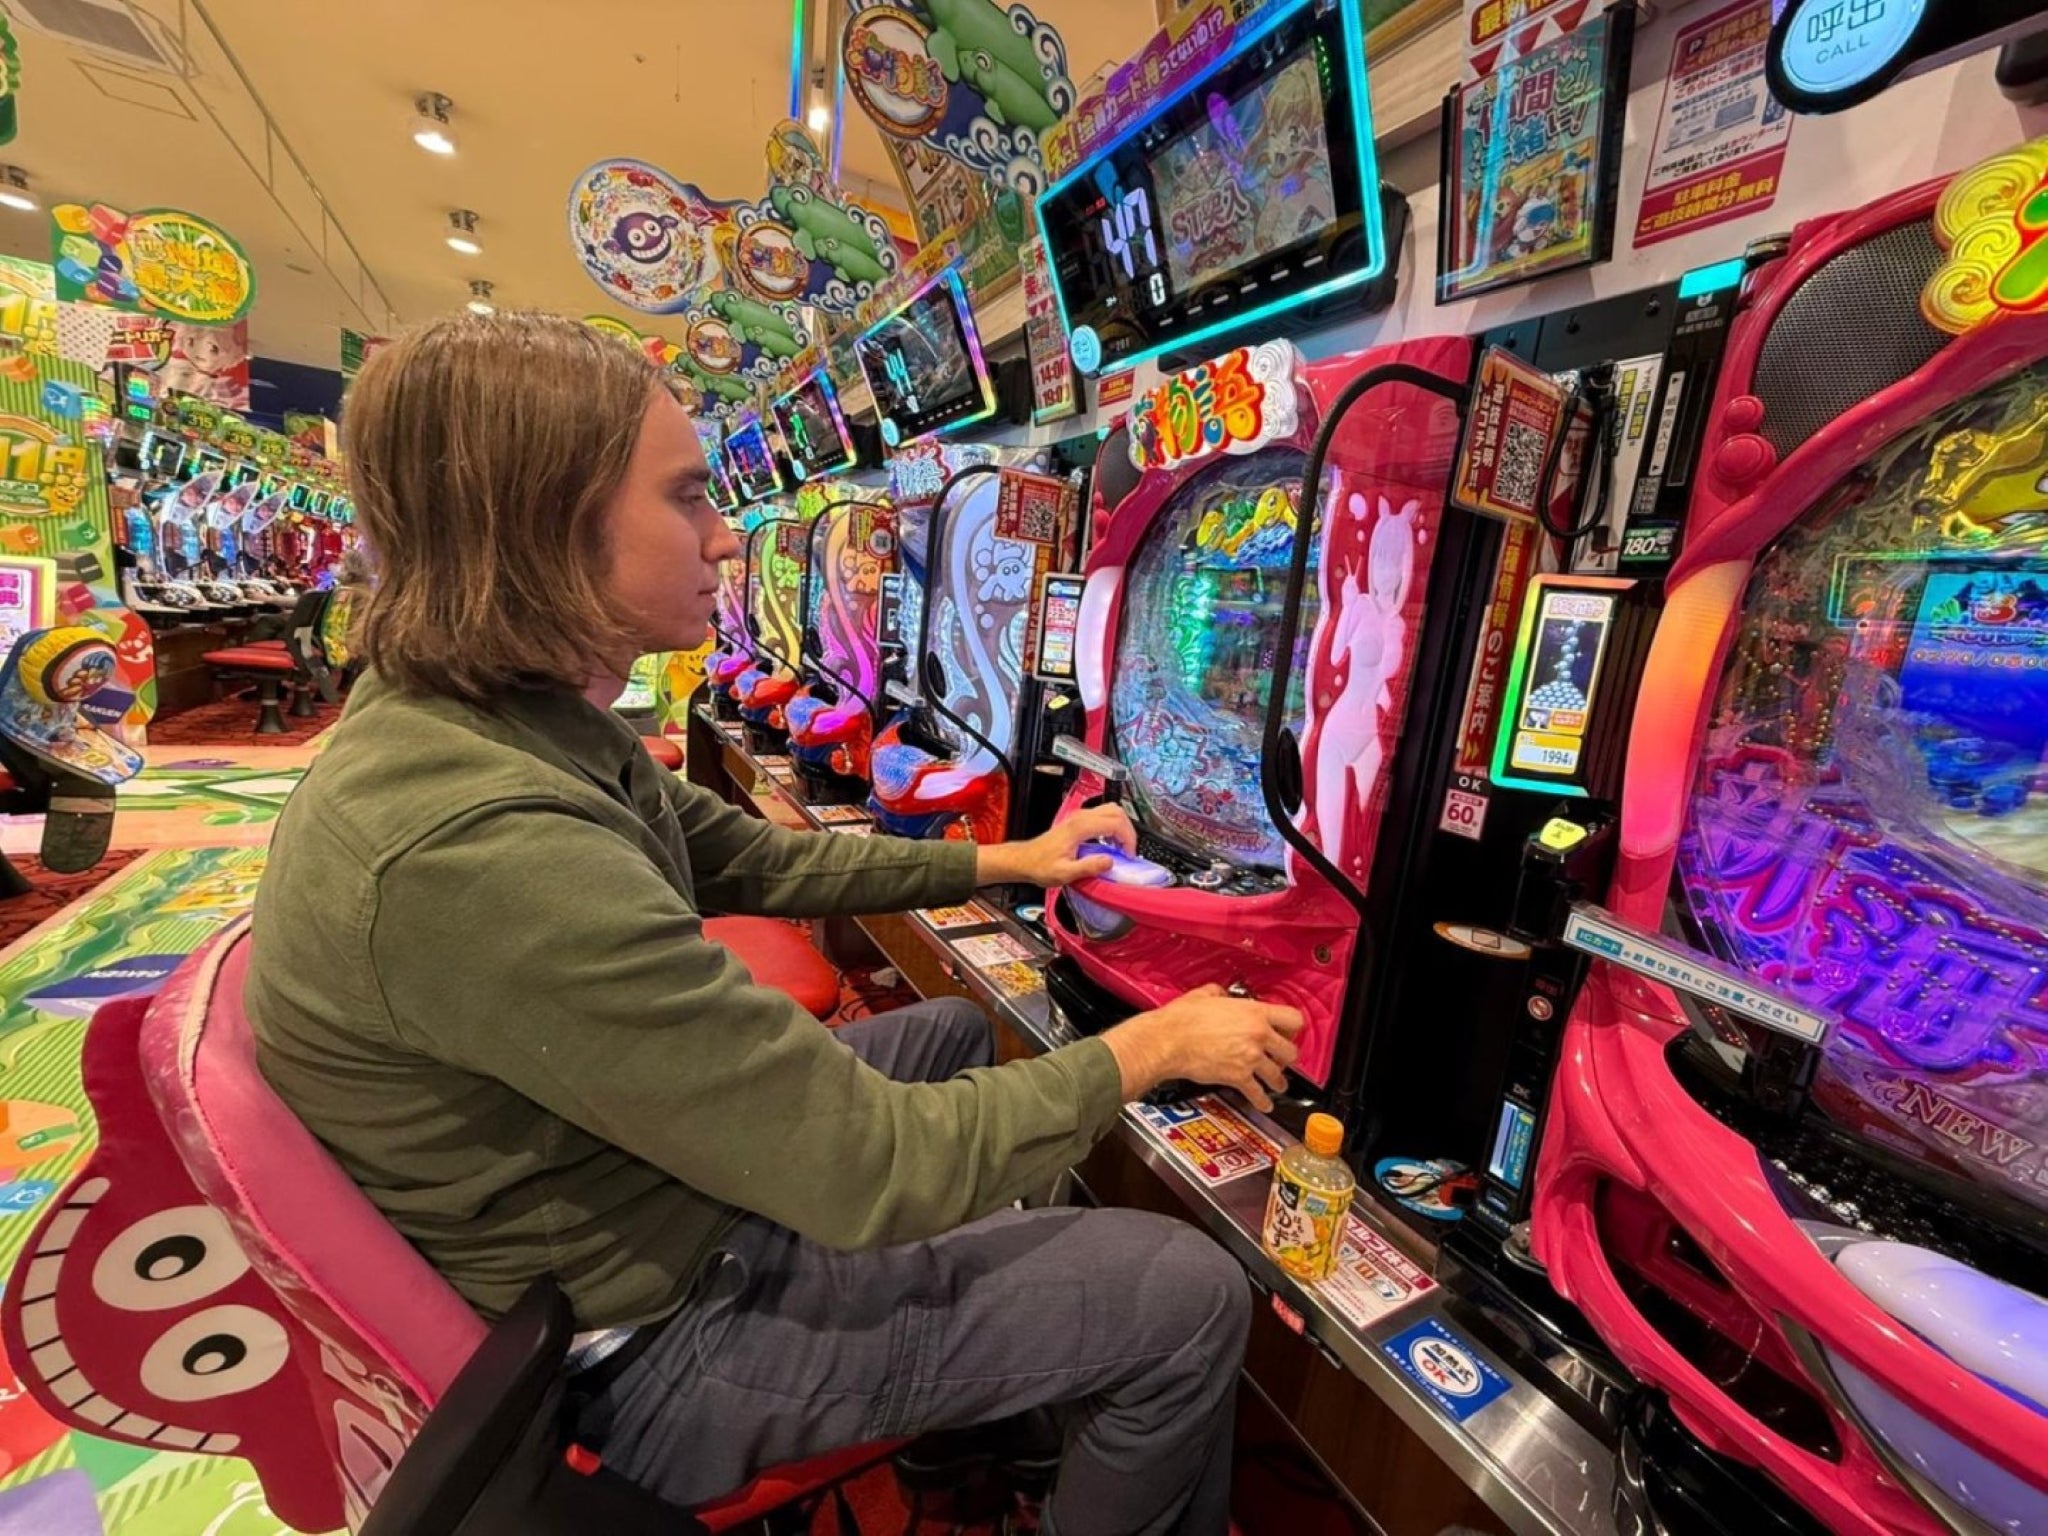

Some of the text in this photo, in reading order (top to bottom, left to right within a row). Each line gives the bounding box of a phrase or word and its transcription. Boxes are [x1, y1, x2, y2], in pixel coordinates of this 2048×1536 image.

[1807, 0, 1885, 43] 呼出
[1815, 34, 1870, 64] CALL
[1673, 172, 1742, 207] 駐車料金
[1101, 186, 1157, 279] 47
[1623, 536, 1656, 556] 180
[1541, 750, 1569, 766] 1994
[1458, 776, 1483, 792] OK
[1447, 803, 1475, 825] 60
[1898, 1083, 2035, 1165] NEW
[1421, 1358, 1446, 1385] OK
